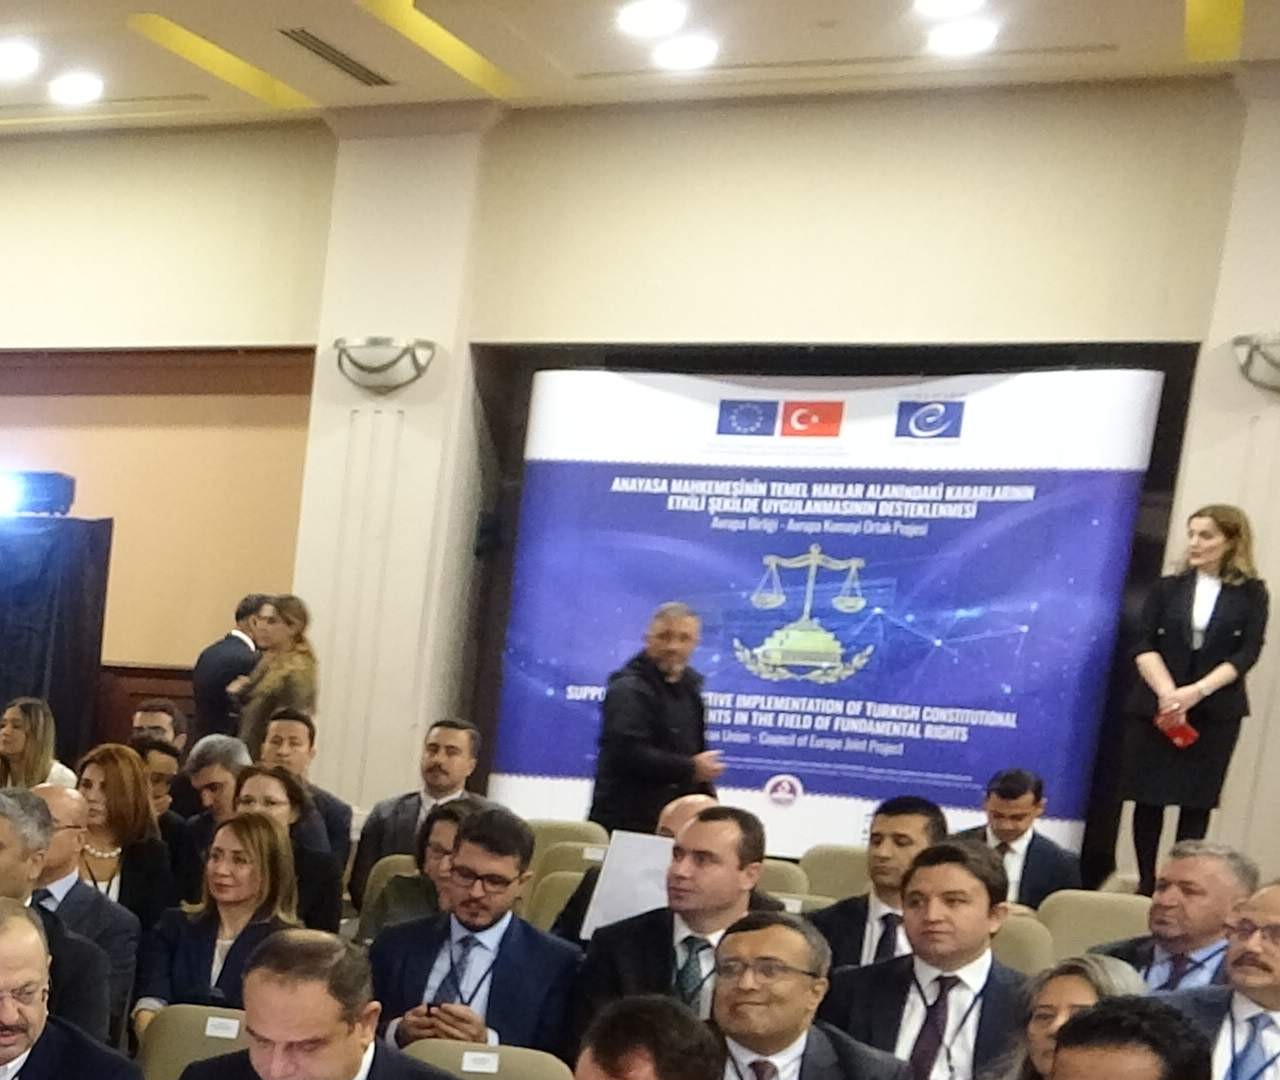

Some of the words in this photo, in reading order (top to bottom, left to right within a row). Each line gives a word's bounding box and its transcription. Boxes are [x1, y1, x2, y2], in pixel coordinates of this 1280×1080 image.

[610, 476, 669, 494] ANAYASA
[769, 482, 808, 498] TEMEL
[811, 483, 865, 499] HAKLAR
[566, 685, 607, 701] SUPPO
[845, 701, 864, 716] OF
[733, 711, 751, 726] IN
[751, 711, 776, 727] THE
[777, 712, 813, 729] FIELD
[813, 716, 832, 731] OF
